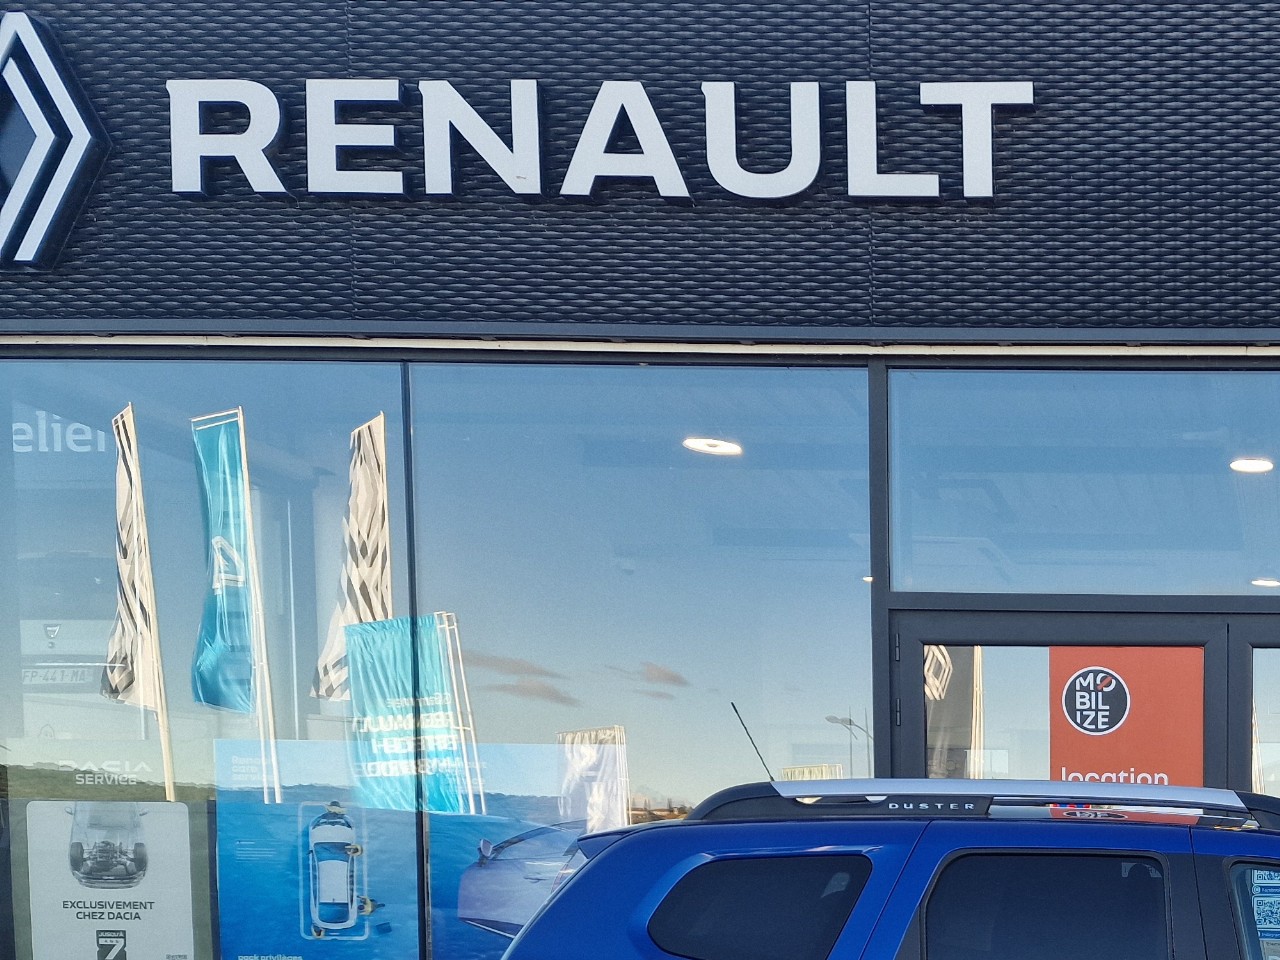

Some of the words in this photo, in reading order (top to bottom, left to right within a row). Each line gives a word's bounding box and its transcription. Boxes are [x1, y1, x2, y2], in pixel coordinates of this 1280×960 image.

[165, 78, 1034, 199] RENAULT
[1075, 691, 1110, 710] BIL
[1076, 711, 1110, 729] IZE
[59, 760, 153, 772] DACIA
[75, 774, 137, 785] SERVICE
[888, 803, 975, 811] DUSTER
[62, 900, 155, 910] EXCLUSIVEMENT
[75, 911, 105, 920] CHEZ
[107, 911, 142, 920] DACIA
[99, 938, 125, 960] 7
